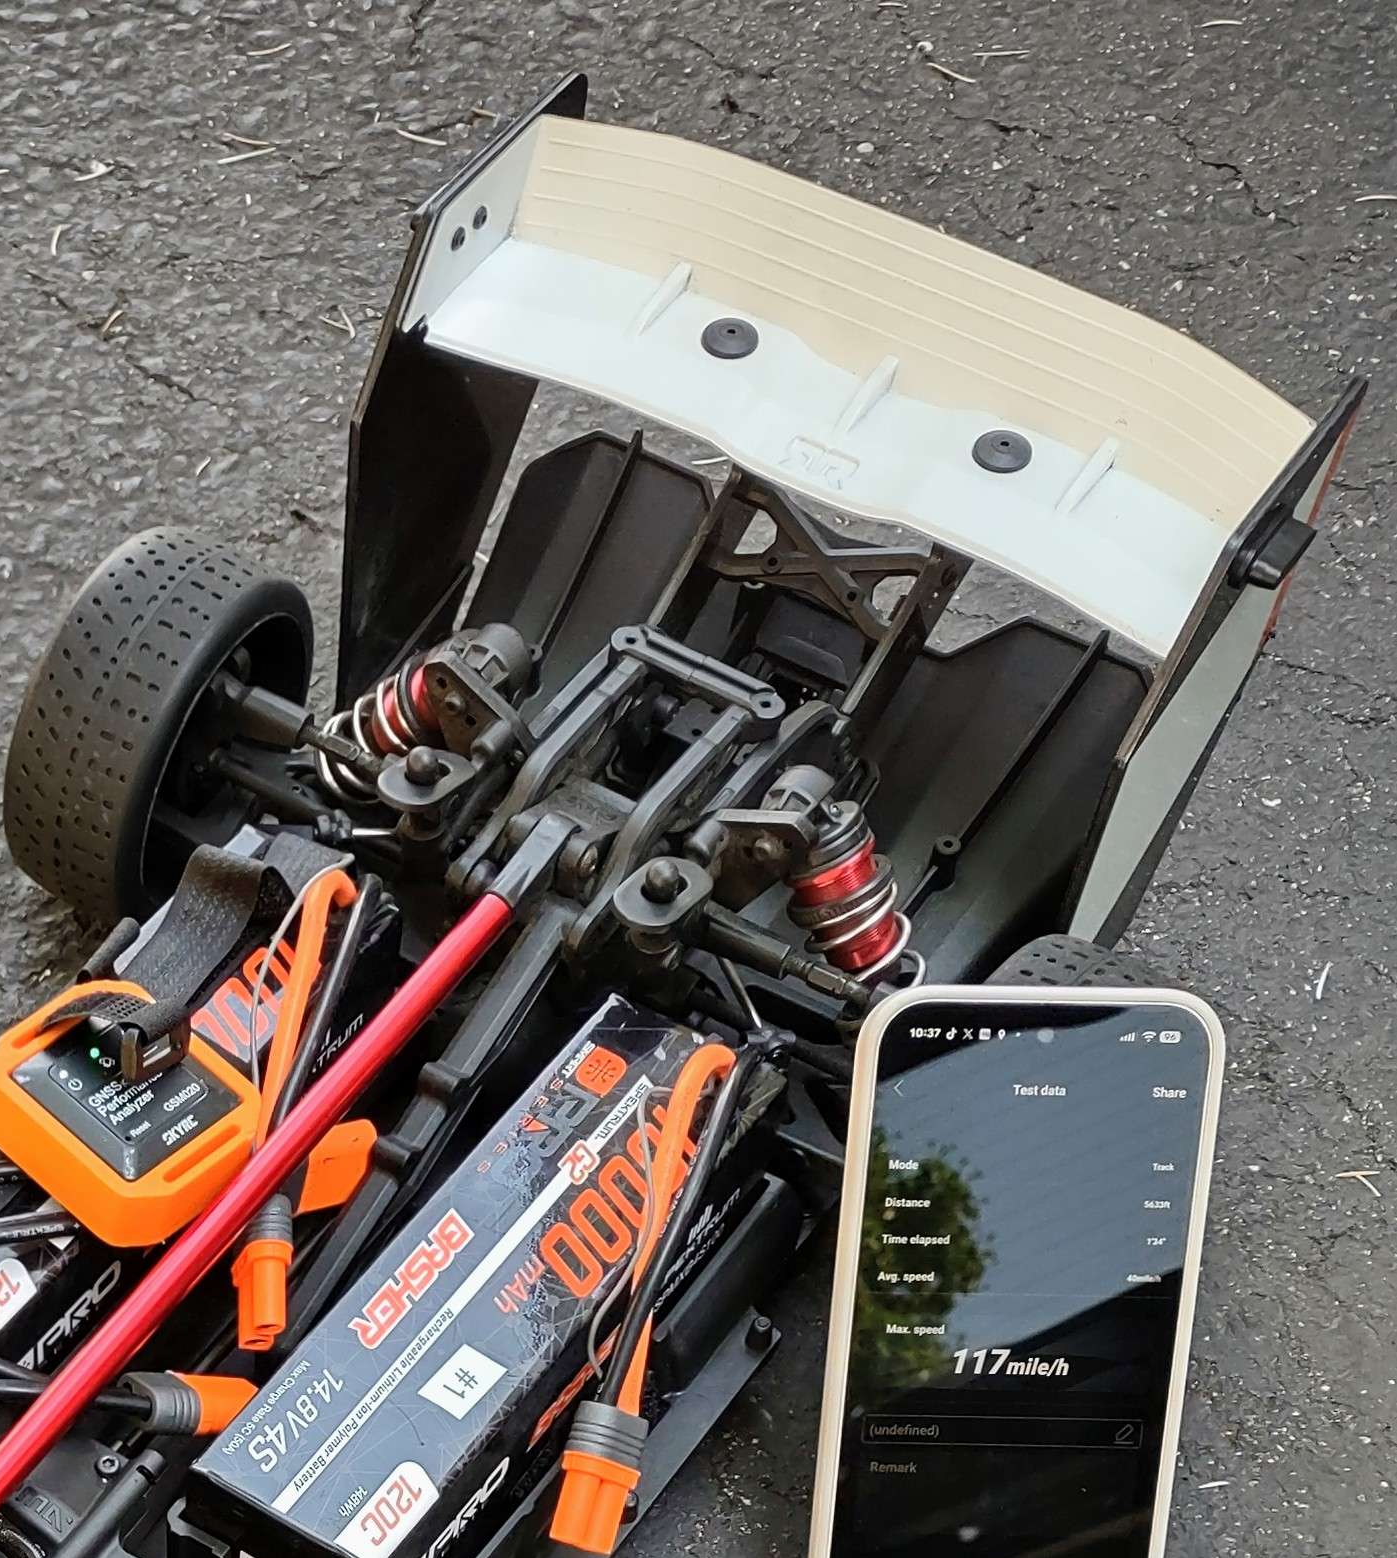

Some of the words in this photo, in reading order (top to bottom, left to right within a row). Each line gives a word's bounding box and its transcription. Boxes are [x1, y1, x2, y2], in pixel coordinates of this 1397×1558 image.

[909, 1028, 941, 1039] 10:37
[88, 1080, 123, 1107] GNSS
[163, 1082, 201, 1112] GSM020
[1013, 1084, 1038, 1096] Test
[1040, 1085, 1066, 1096] data
[1153, 1087, 1187, 1099] Share
[109, 1089, 155, 1126] Analyzer
[162, 1114, 199, 1146] SKYRC
[559, 1140, 600, 1185] G2
[888, 1160, 919, 1170] Mode
[885, 1197, 931, 1208] Distance
[882, 1234, 908, 1244] Time
[910, 1234, 951, 1246] elapsed
[877, 1271, 901, 1283] Avg.
[903, 1271, 935, 1283] speed
[396, 1306, 456, 1370] Rechargeable
[886, 1324, 911, 1334] Max.
[913, 1324, 946, 1337] speed
[290, 1360, 311, 1378] Max
[268, 1377, 295, 1404] Charge
[353, 1366, 405, 1422] Lithium-Ion
[443, 1368, 478, 1399] #1
[252, 1403, 272, 1423] Rate
[320, 1416, 359, 1457] Polymer
[869, 1424, 940, 1439] (undefined)
[290, 1453, 328, 1493] Battery
[870, 1461, 917, 1474] Remark
[339, 1486, 368, 1518] 148Wh
[360, 1474, 422, 1546] 120C
